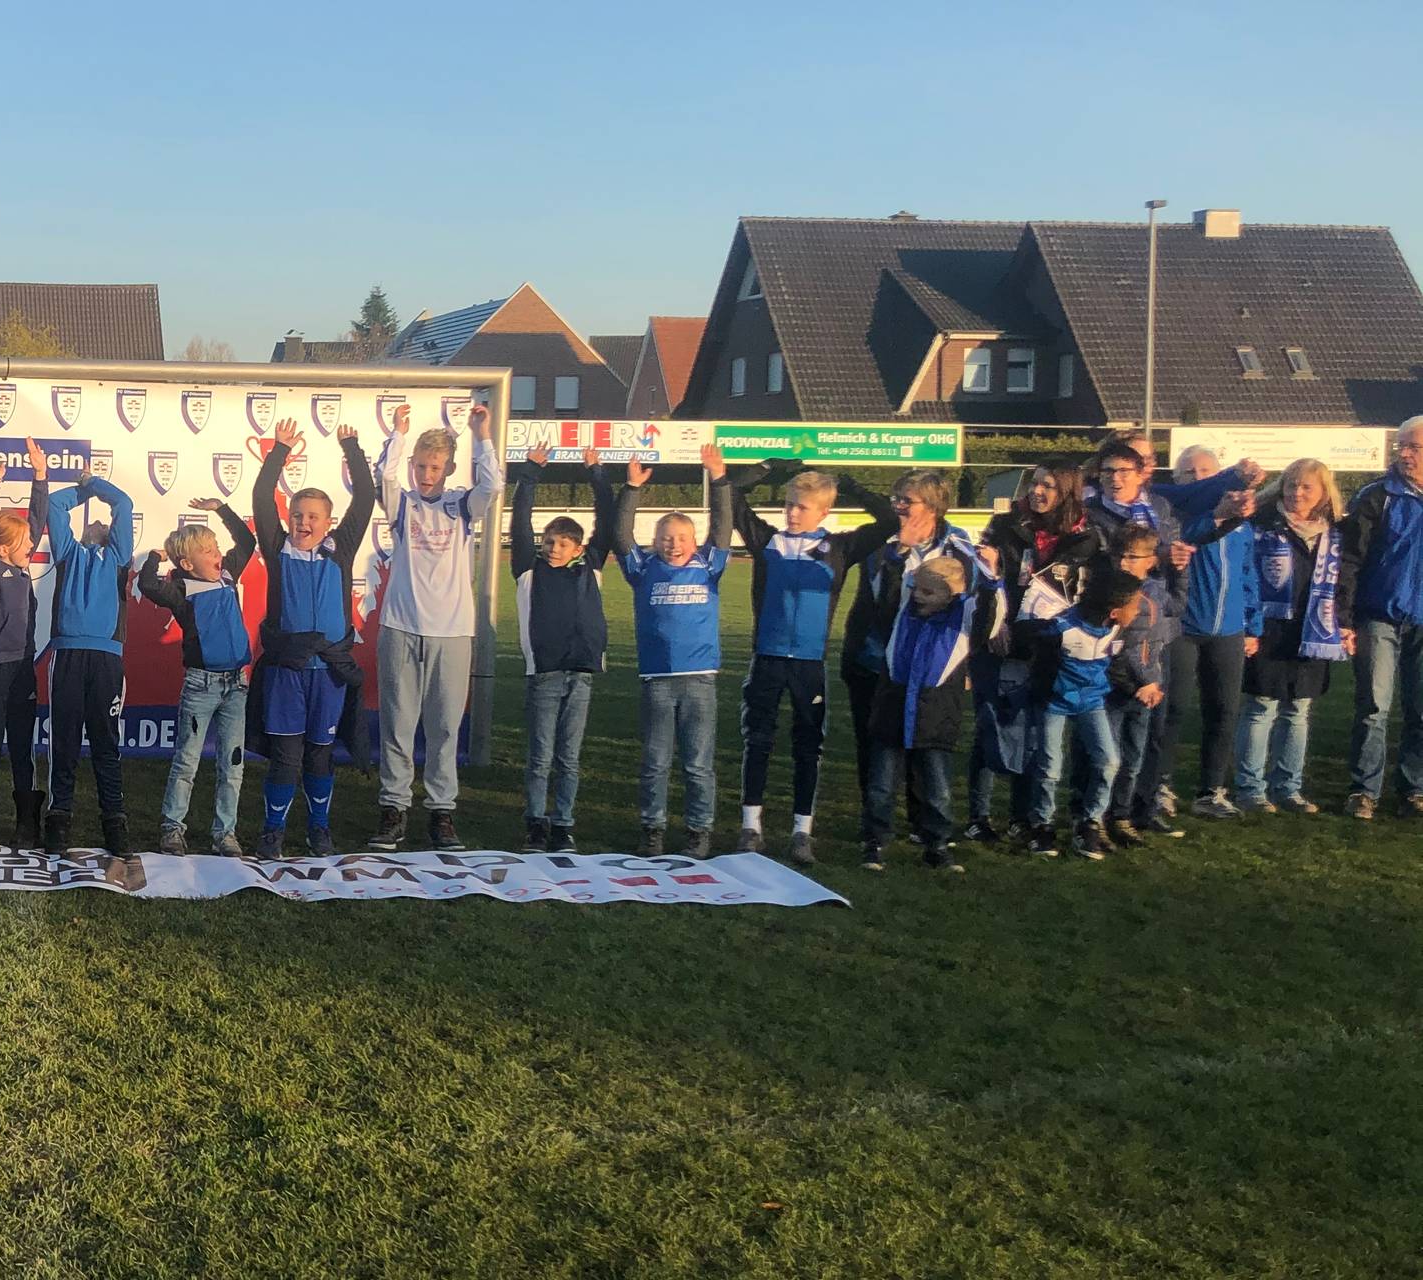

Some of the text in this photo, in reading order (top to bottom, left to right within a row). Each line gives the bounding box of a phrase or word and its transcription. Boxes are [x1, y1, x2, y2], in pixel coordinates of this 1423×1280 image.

[717, 437, 794, 448] PROVINZIAL
[818, 432, 955, 444] Helmich & Kremer OHG
[669, 585, 708, 594] REIFEN
[650, 594, 708, 605] STIEBLING
[242, 863, 508, 884] WMW
